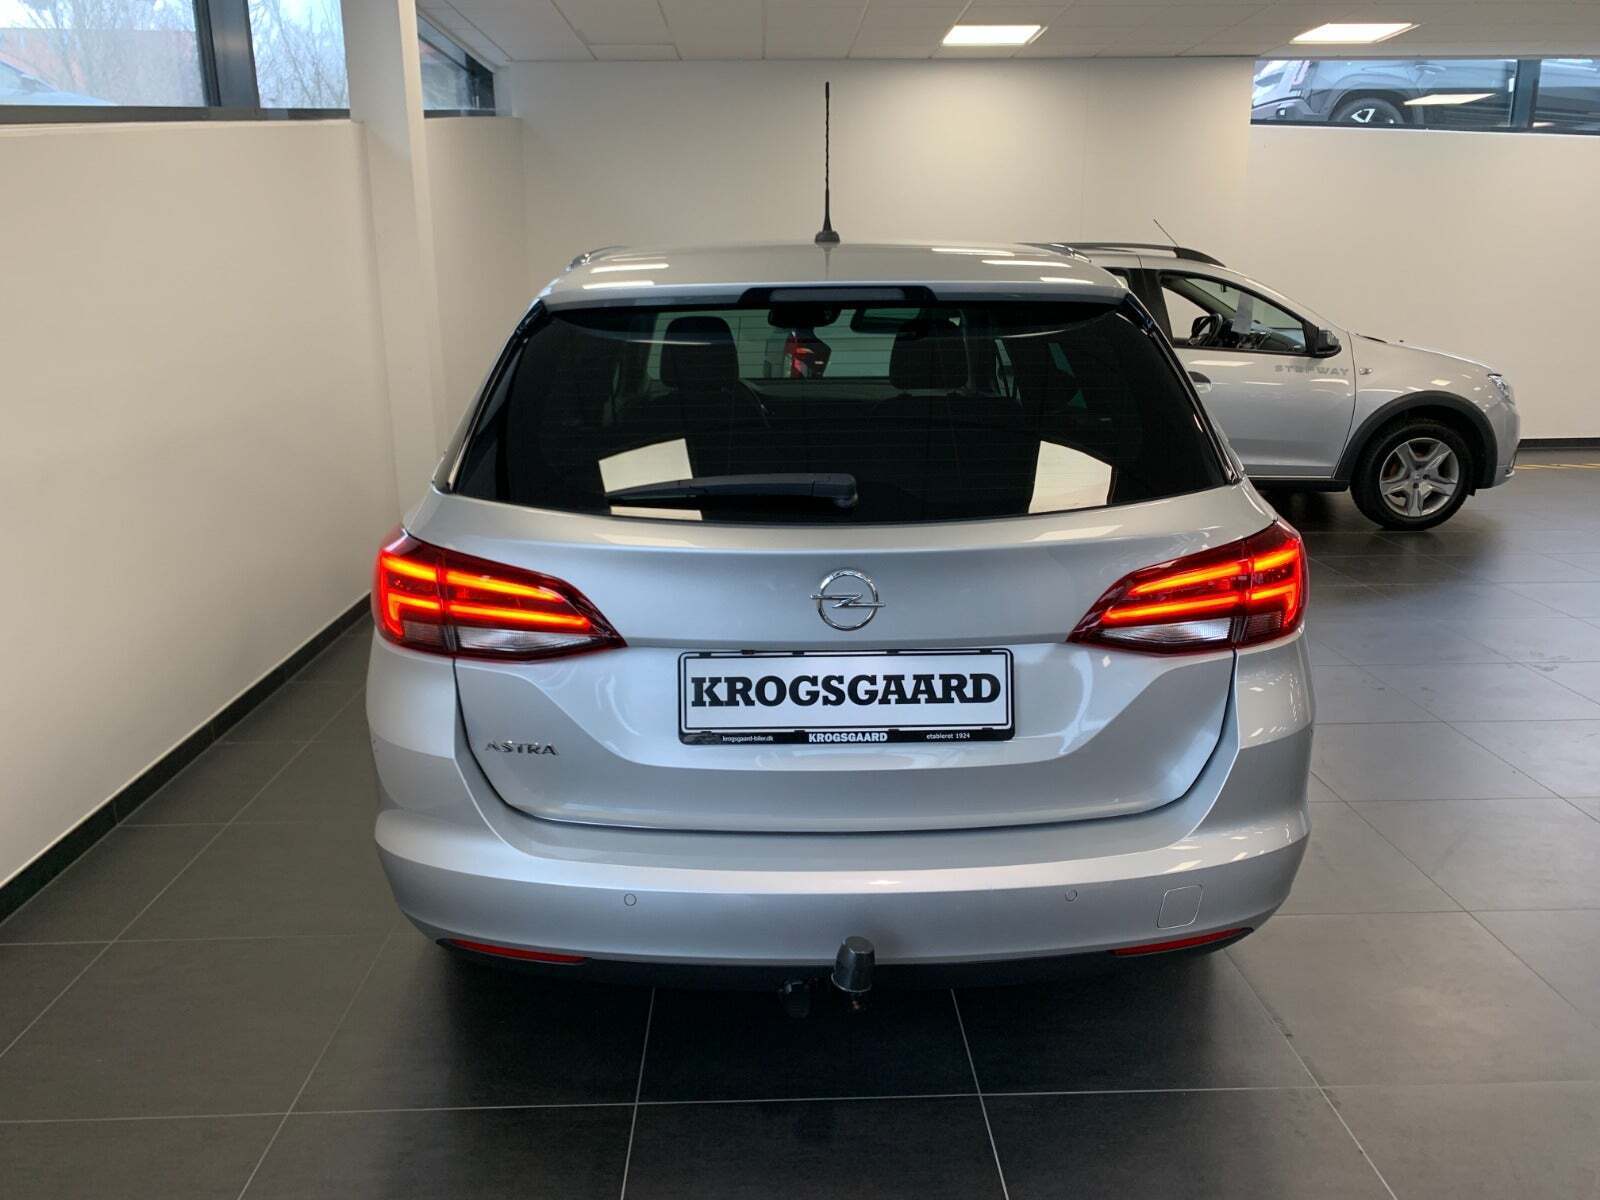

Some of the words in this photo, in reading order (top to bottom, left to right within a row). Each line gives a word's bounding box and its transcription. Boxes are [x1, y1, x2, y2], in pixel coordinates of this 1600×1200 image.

[691, 673, 1001, 707] KROGSGAARD
[808, 732, 888, 743] KROGSGAARD
[484, 741, 557, 756] ASTRA
